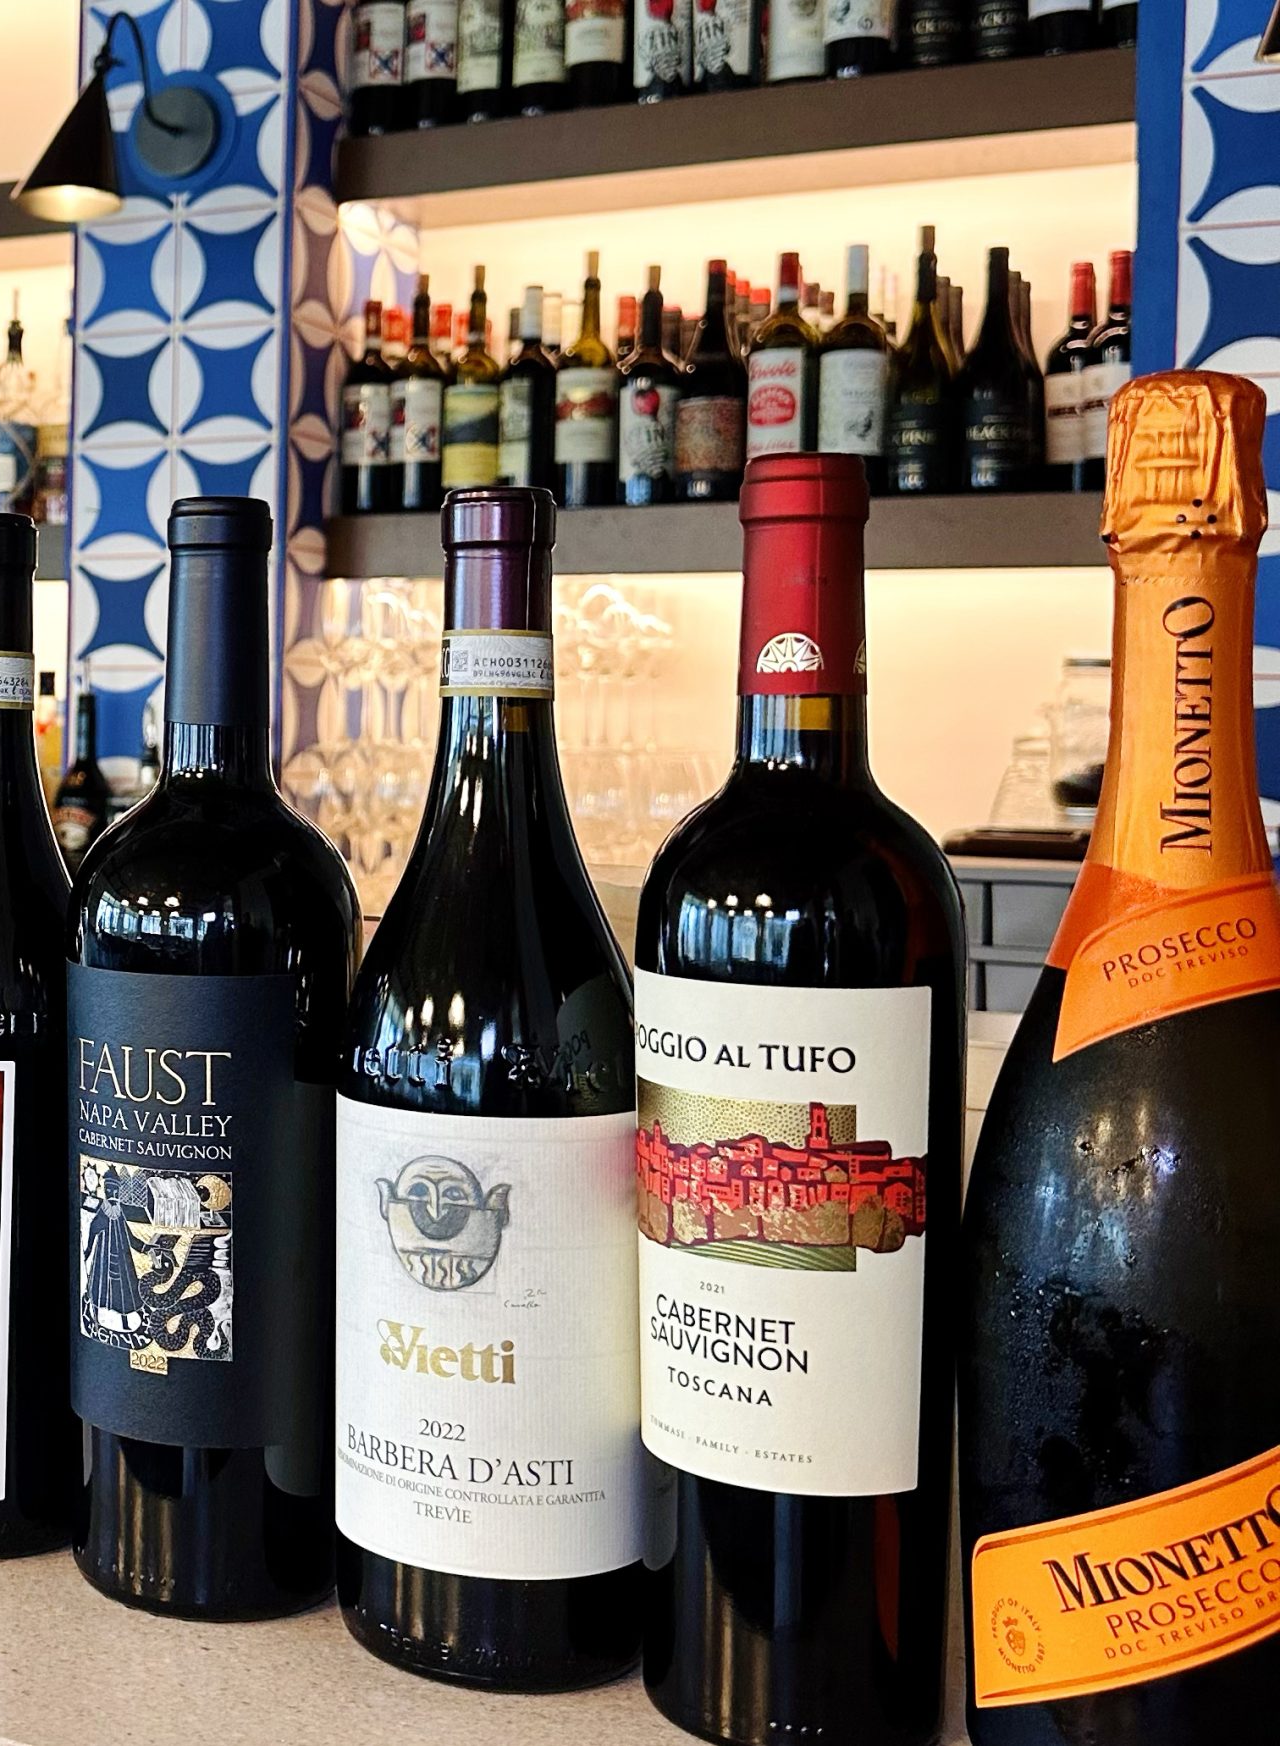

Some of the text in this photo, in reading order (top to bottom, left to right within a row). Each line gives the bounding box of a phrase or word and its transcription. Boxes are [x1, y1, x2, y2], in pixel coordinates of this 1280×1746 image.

[1160, 596, 1215, 857] MIONETTO
[1101, 917, 1258, 983] PROSECCO
[1128, 945, 1249, 989] DOC TREVISO
[78, 1036, 232, 1107] FAUST
[714, 1043, 751, 1069] AL
[758, 1043, 857, 1074] TUFO
[78, 1097, 234, 1138] NAPA VALLEY
[78, 1127, 233, 1161] CABERNET SAUVIGNON
[699, 1280, 726, 1295] 2021
[655, 1292, 796, 1346] CABERNET
[131, 1351, 167, 1372] 2022
[376, 1317, 517, 1385] Vietti
[650, 1315, 809, 1375] SAUVIGNON
[666, 1365, 773, 1408] TOSCANA
[418, 1418, 467, 1442] 2022
[695, 1435, 740, 1455] FAMILY
[754, 1449, 813, 1464] ESTATES
[347, 1423, 575, 1487] BARBERA D'ASTI
[385, 1475, 397, 1488] DI
[397, 1480, 443, 1498] ORIGINE
[444, 1487, 535, 1507] CONTROLLATA
[537, 1495, 544, 1507] E
[545, 1489, 607, 1506] GARANTITA
[1105, 1557, 1280, 1640] PROSECCO
[1104, 1639, 1148, 1660] DOC
[1156, 1606, 1244, 1646] TREVISO
